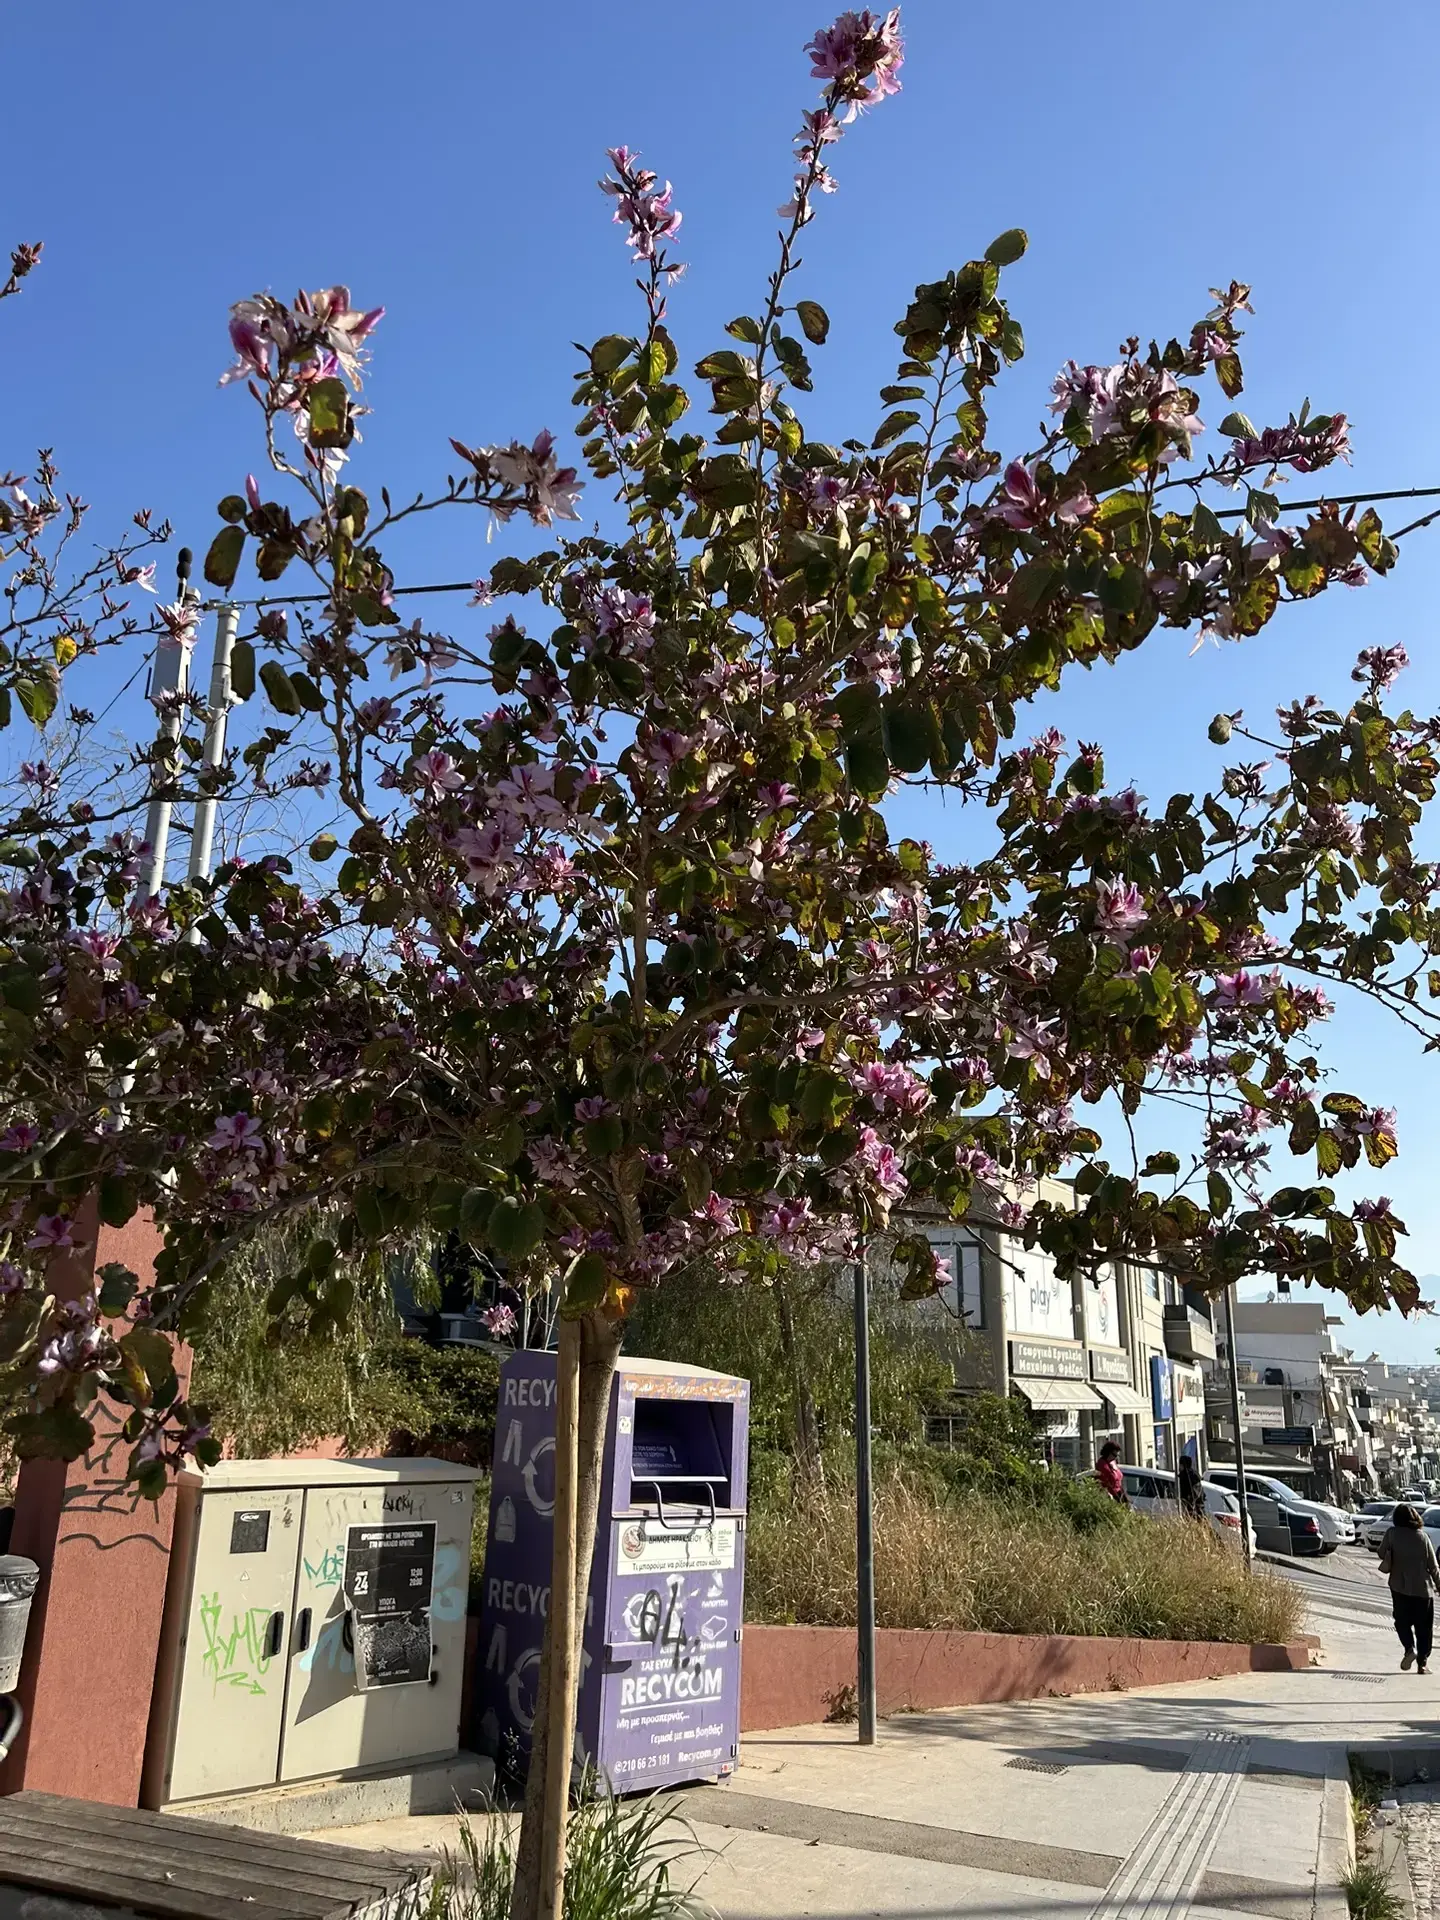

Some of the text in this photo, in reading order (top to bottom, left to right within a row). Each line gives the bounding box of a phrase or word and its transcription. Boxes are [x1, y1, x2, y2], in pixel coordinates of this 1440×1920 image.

[1030, 1280, 1051, 1316] play
[504, 1378, 558, 1407] RECY
[648, 1535, 671, 1544] ΔΗΜΟΣ
[354, 1576, 369, 1591] 24
[641, 1660, 655, 1671] ΣΑΣ
[621, 1668, 722, 1706] RECYCOM
[616, 1717, 629, 1730] Μη
[630, 1717, 640, 1729] με
[674, 1731, 683, 1742] με
[622, 1758, 635, 1772] 210
[637, 1757, 647, 1770] 66
[648, 1756, 657, 1768] 25
[678, 1747, 722, 1763] Recycom.gr
